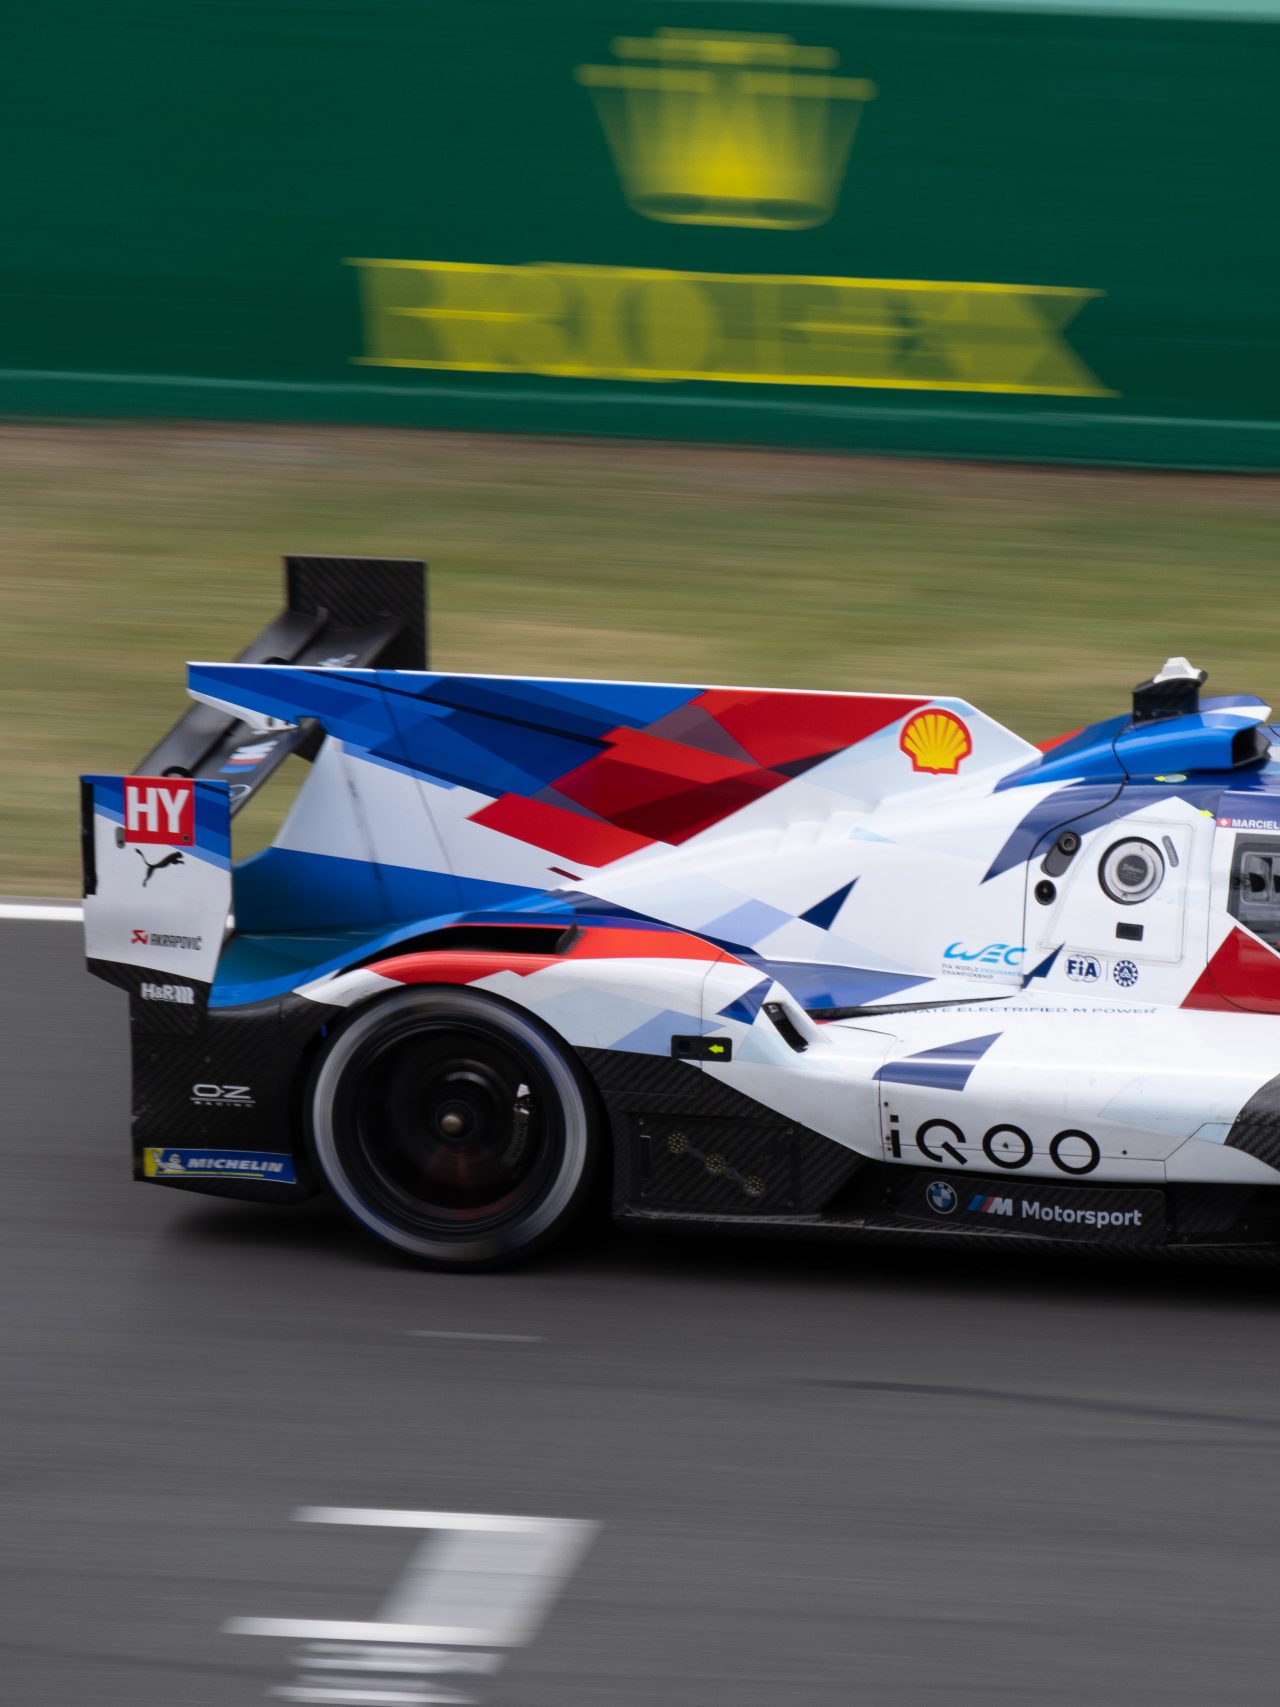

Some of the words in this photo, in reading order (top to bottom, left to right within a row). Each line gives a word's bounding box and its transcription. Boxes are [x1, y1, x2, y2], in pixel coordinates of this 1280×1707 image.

[126, 785, 190, 835] HY
[943, 941, 1028, 966] WEC
[889, 1113, 1101, 1175] iQOO
[187, 1157, 284, 1173] MICHELIN
[1020, 1200, 1143, 1229] Motorsport
